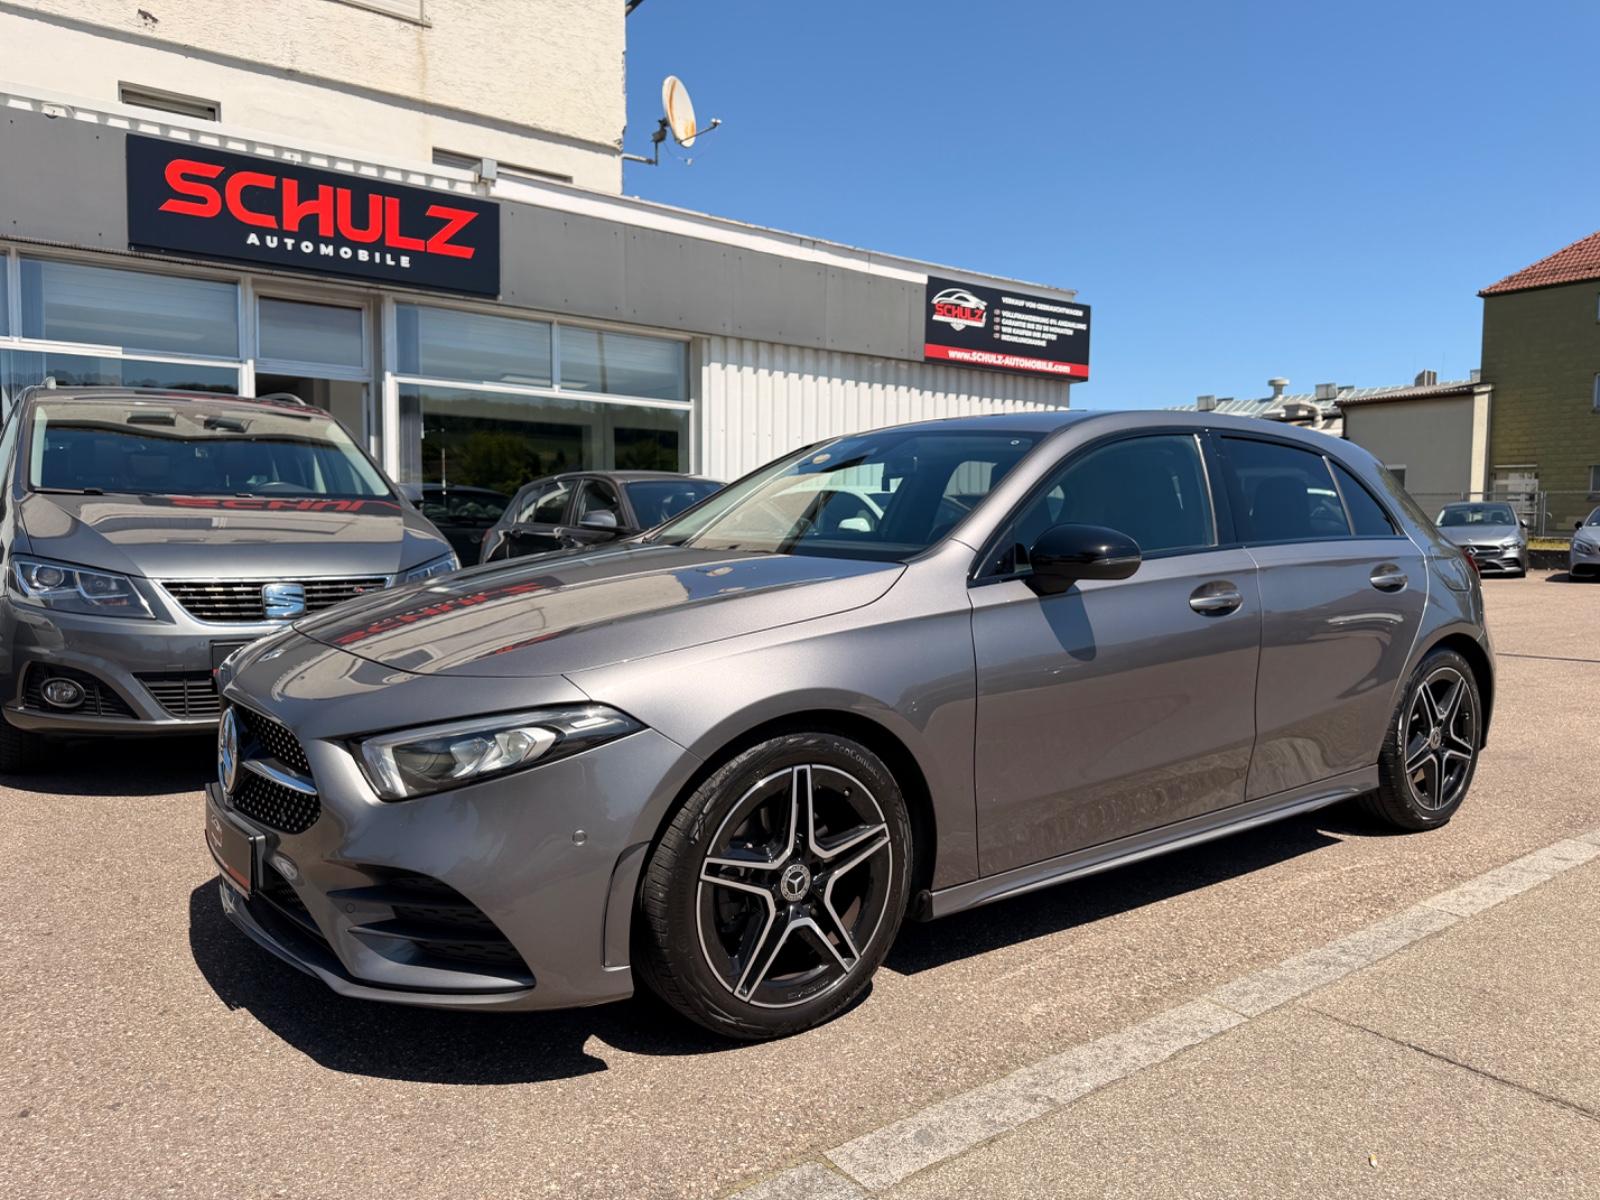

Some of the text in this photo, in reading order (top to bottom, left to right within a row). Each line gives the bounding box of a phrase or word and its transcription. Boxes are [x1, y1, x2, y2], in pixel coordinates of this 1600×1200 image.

[159, 159, 479, 259] SCHULZ
[247, 232, 411, 268] AUTOMOBILE
[935, 303, 984, 322] SCHULZ
[948, 350, 1071, 373] www.SCHULZ-AUTOMOBILE.com
